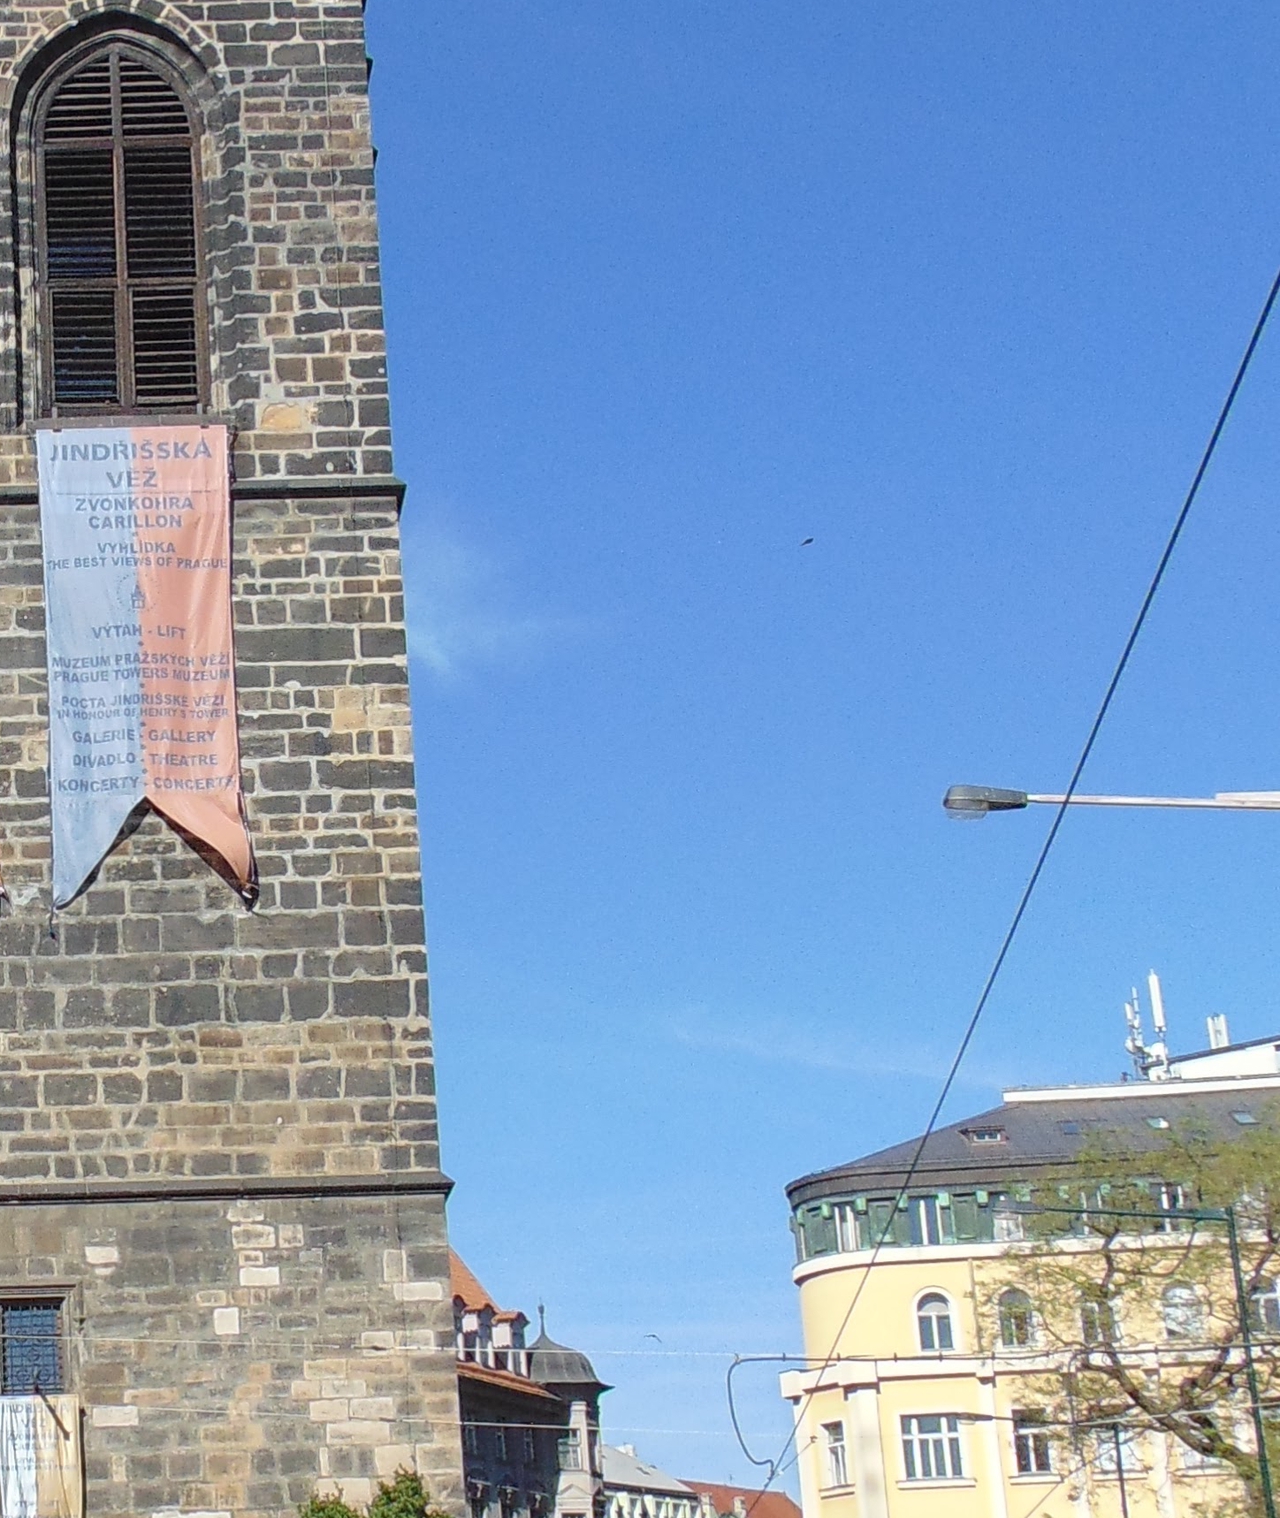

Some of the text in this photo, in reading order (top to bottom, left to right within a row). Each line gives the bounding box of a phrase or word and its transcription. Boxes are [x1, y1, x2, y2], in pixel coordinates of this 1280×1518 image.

[75, 496, 195, 511] ZVONKOHRA
[88, 514, 182, 529] CARILLON
[47, 557, 228, 570] THE BEST VIEWS OF PRAGUE
[157, 625, 187, 639] LIFT
[52, 655, 111, 669] MUZEUM
[54, 667, 230, 683] PRAGUE TOWERS MUZEUM
[61, 696, 106, 709] POCTA
[57, 709, 70, 719] IN
[73, 708, 120, 720] HONOUR
[123, 708, 136, 717] OF
[189, 708, 228, 719] TOWER
[72, 729, 136, 745] GALERIE
[148, 729, 216, 743] GALLERY
[72, 753, 136, 768] DIVADLO
[149, 753, 218, 768] THEATRE
[58, 776, 140, 793] KONCERTY
